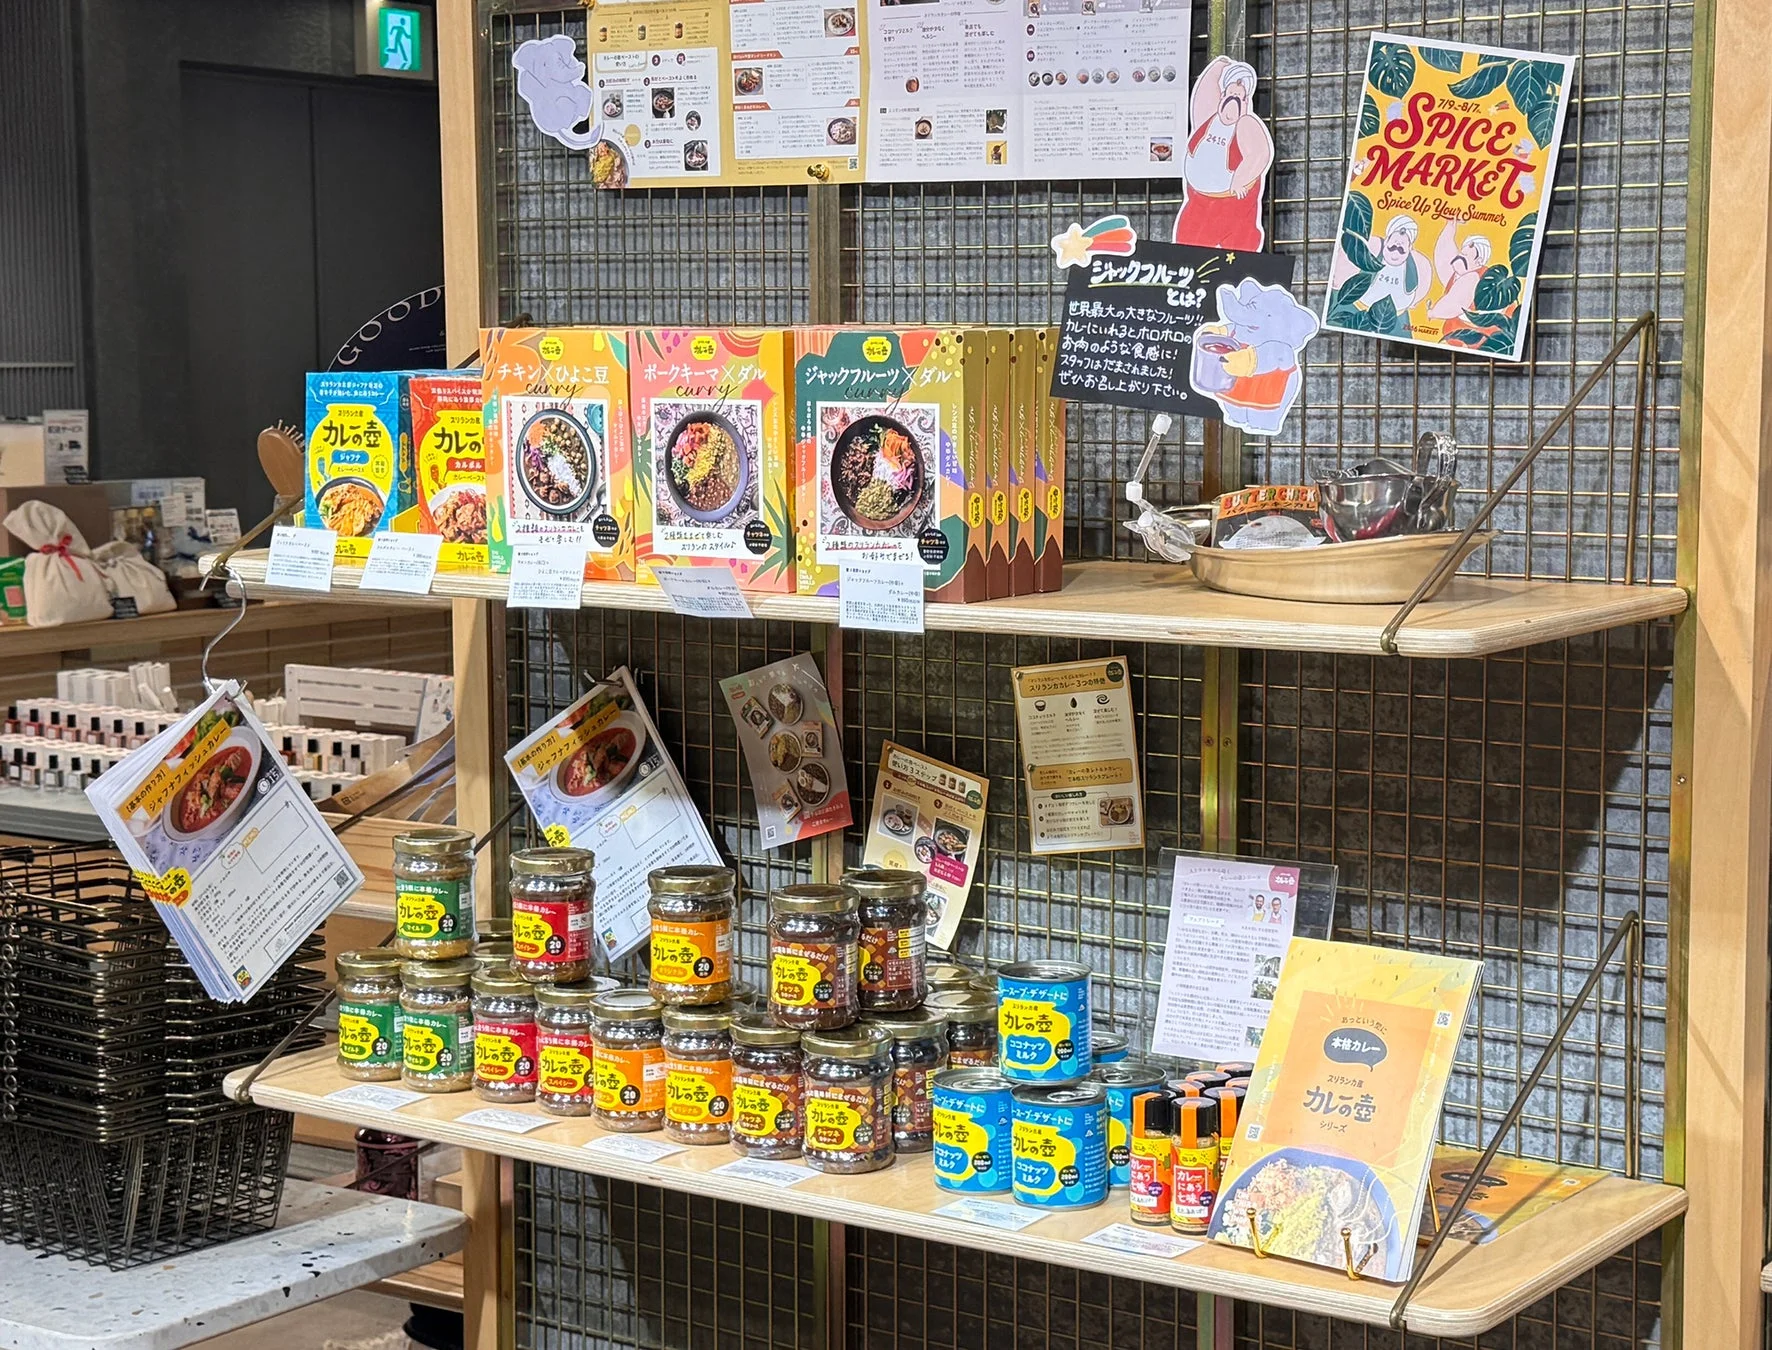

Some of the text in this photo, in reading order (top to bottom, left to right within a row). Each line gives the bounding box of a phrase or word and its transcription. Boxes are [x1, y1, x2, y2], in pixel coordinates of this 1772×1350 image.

[1384, 92, 1516, 156] SPICE
[1361, 144, 1537, 210] MARKET
[1377, 190, 1508, 228] Spice Up Your Summer
[1090, 260, 1197, 286] ジャックフルーツ
[1062, 336, 1178, 361] お肉のような食感に!
[497, 363, 610, 385] チキン×ひよこ豆
[644, 363, 767, 384] ポークキーマ×ダル
[1060, 354, 1174, 381] スタッフはだまされました!
[805, 366, 952, 387] ジャックフルーツ×ダル
[1058, 369, 1188, 400] ぜひお召し上がり下さい。
[526, 382, 584, 408] curry
[676, 383, 738, 413] curry
[844, 386, 912, 415] curry
[338, 409, 364, 418] スリランカ産
[322, 419, 382, 448] カレーの壺
[433, 426, 485, 455] カレーの
[339, 453, 361, 462] ジャフナ
[1223, 488, 1277, 509] BUTTER
[456, 550, 485, 563] カレーの壺
[537, 709, 617, 770] ジャフナフィッシュカレー
[149, 727, 228, 812] ジャフナフィッシュカレー
[398, 904, 439, 920] カレーの壺
[442, 919, 454, 928] 20
[549, 940, 562, 950] 20
[653, 946, 694, 964] カレーの壺
[697, 962, 710, 972] 20
[775, 966, 809, 982] カレーの壺
[779, 984, 801, 993] チャツネ
[1004, 1011, 1053, 1033] カレーの壺
[375, 1042, 388, 1051] 20
[1009, 1038, 1045, 1051] ココナッツ
[1331, 1036, 1381, 1053] 本格カレー
[440, 1053, 452, 1062] 20
[476, 1046, 515, 1063] カレーの壺
[1015, 1049, 1037, 1061] ミルク
[518, 1061, 530, 1070] 20
[542, 1057, 584, 1075] カレーの壺
[548, 1078, 573, 1087] スパイシー
[1327, 1074, 1364, 1088] スリランカ産
[624, 1090, 636, 1100] 20
[668, 1085, 709, 1103] カレーの壺
[713, 1101, 725, 1111] 20
[736, 1095, 770, 1112] カレーの壺
[1303, 1086, 1377, 1123] カレーの壺
[740, 1113, 762, 1124] チャツネ
[812, 1108, 849, 1127] カレーの壺
[817, 1129, 841, 1138] チャツネ
[1319, 1120, 1348, 1133] シリーズ
[1013, 1133, 1057, 1158] カレーの壺
[939, 1157, 956, 1169] ミルク
[1016, 1162, 1049, 1175] ココナッツ
[1022, 1173, 1041, 1185] ミルク
[1177, 1170, 1203, 1182] カレー
[1177, 1182, 1202, 1192] にあう
[1178, 1192, 1199, 1204] 七味
